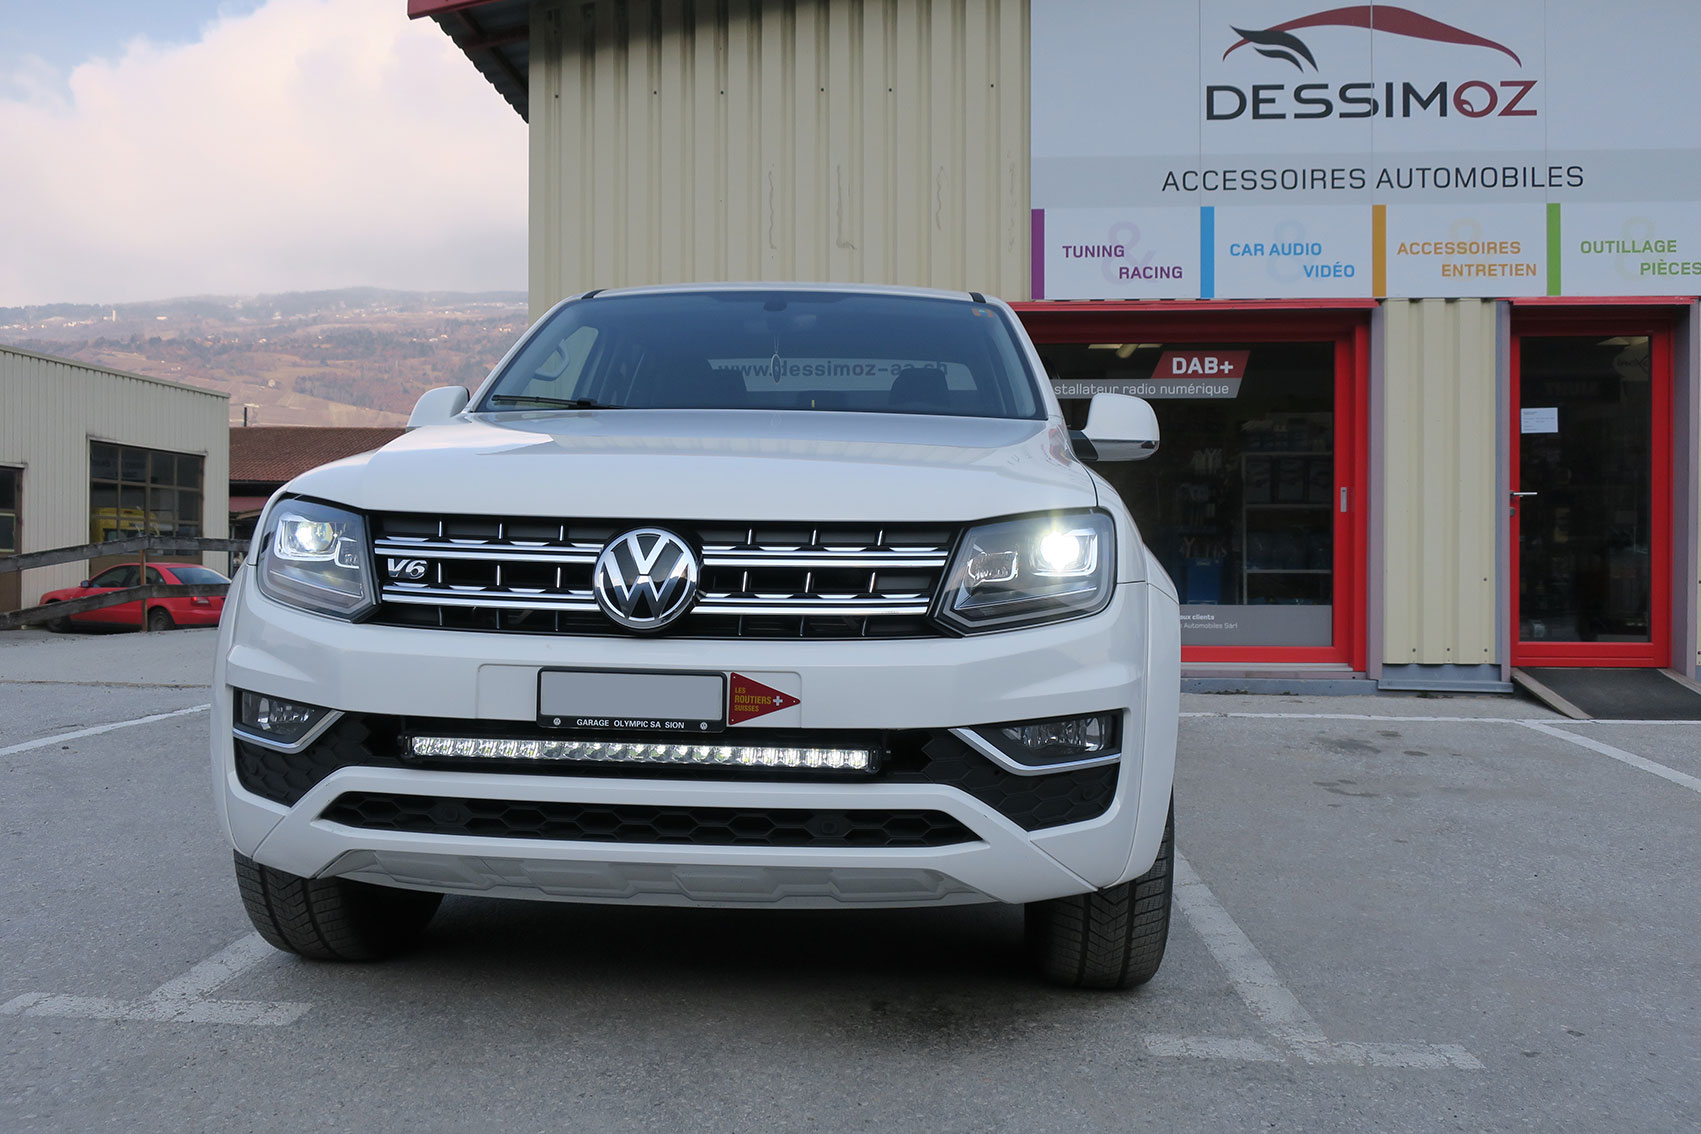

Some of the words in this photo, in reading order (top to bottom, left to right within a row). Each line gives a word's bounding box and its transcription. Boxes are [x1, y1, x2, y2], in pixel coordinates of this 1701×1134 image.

[1206, 80, 1538, 121] DESSIMOZ
[1162, 168, 1366, 192] ACCESSOIRES
[1376, 165, 1584, 190] AUTOMOBILES
[1062, 245, 1125, 259] TUNING
[1229, 243, 1265, 257] CAR
[1269, 242, 1322, 257] AUDIO
[1397, 240, 1521, 256] ACCESSOIRES
[1580, 239, 1677, 254] OUTILLAGE
[1119, 266, 1183, 280] RACING
[1303, 261, 1355, 279] VIDÉO
[1441, 263, 1537, 277] ENTRETIEN
[1640, 258, 1701, 276] PIÈCES
[1172, 357, 1234, 375] DAB+
[1054, 383, 1120, 395] stallateur
[1122, 383, 1156, 395] radio
[1159, 383, 1229, 396] numérique
[387, 557, 428, 581] V6
[1191, 613, 1215, 621] clients
[1183, 622, 1223, 630] Automobiles
[734, 695, 772, 705] ROUTIERS
[734, 705, 760, 713] SUISSES
[576, 718, 610, 728] GARAGE
[613, 719, 650, 729] OLYMPIC
[649, 720, 662, 729] SA
[664, 720, 685, 730] SION
